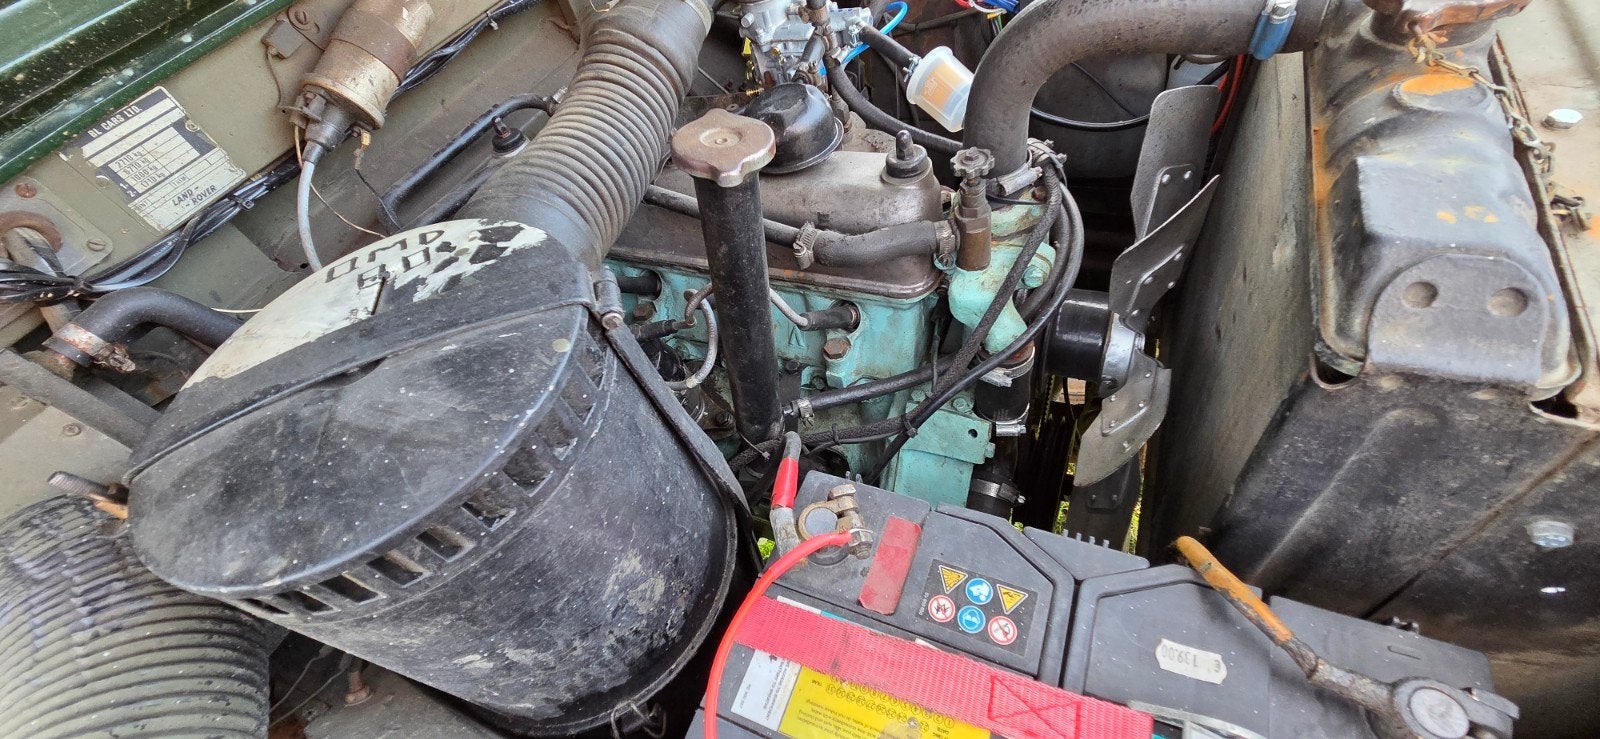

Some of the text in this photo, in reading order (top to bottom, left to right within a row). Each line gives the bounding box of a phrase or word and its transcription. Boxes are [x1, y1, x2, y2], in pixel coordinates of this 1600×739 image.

[87, 128, 102, 138] BL
[100, 114, 125, 131] CARS
[115, 154, 134, 168] 2710
[130, 169, 149, 182] 1000
[140, 176, 158, 188] 1710
[1161, 644, 1198, 667] 139.00
